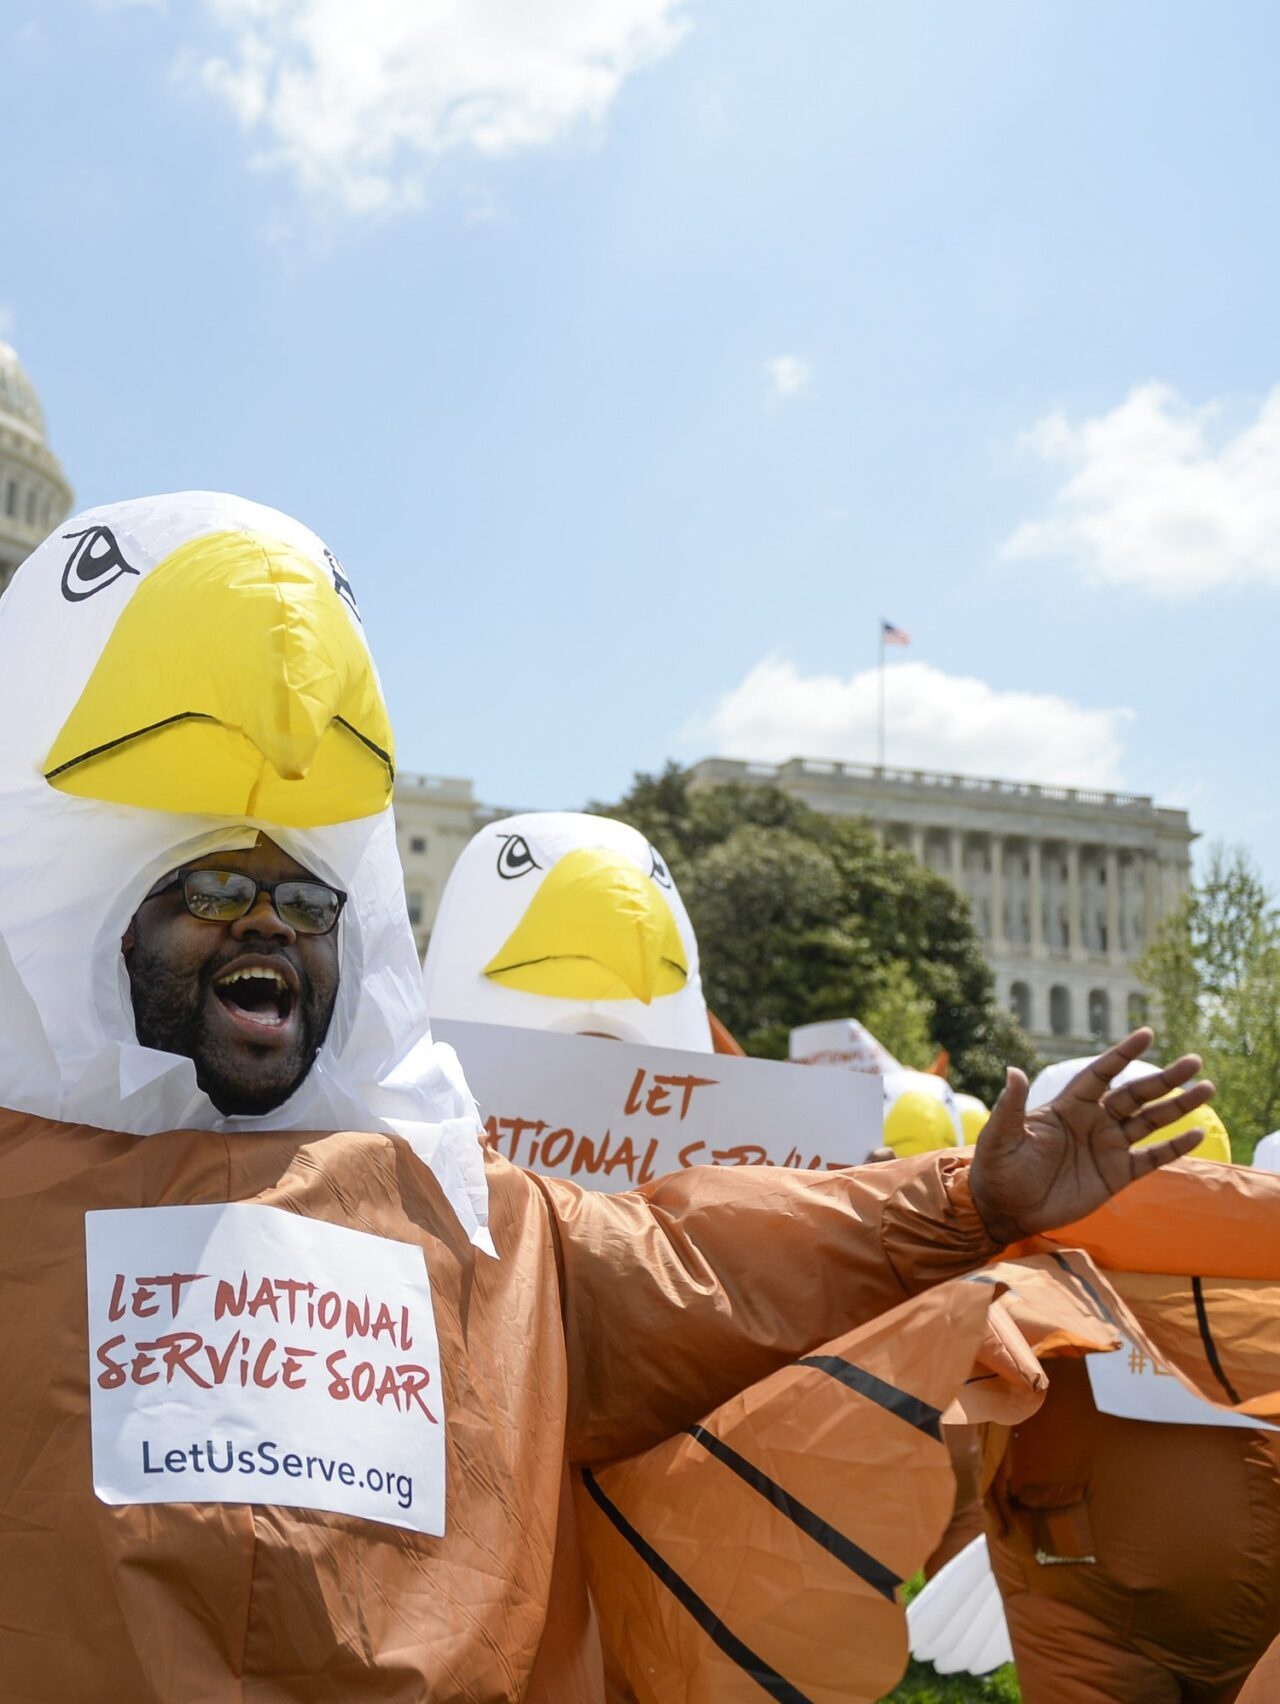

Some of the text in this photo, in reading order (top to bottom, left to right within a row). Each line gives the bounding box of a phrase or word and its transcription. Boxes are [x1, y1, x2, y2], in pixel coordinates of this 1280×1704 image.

[624, 1067, 721, 1121] LET
[485, 1115, 658, 1185] ATIONAL
[108, 1270, 414, 1351] LET NATIONAL
[96, 1330, 439, 1424] SERVICE SOAR
[142, 1440, 413, 1509] LetUsServe.org
